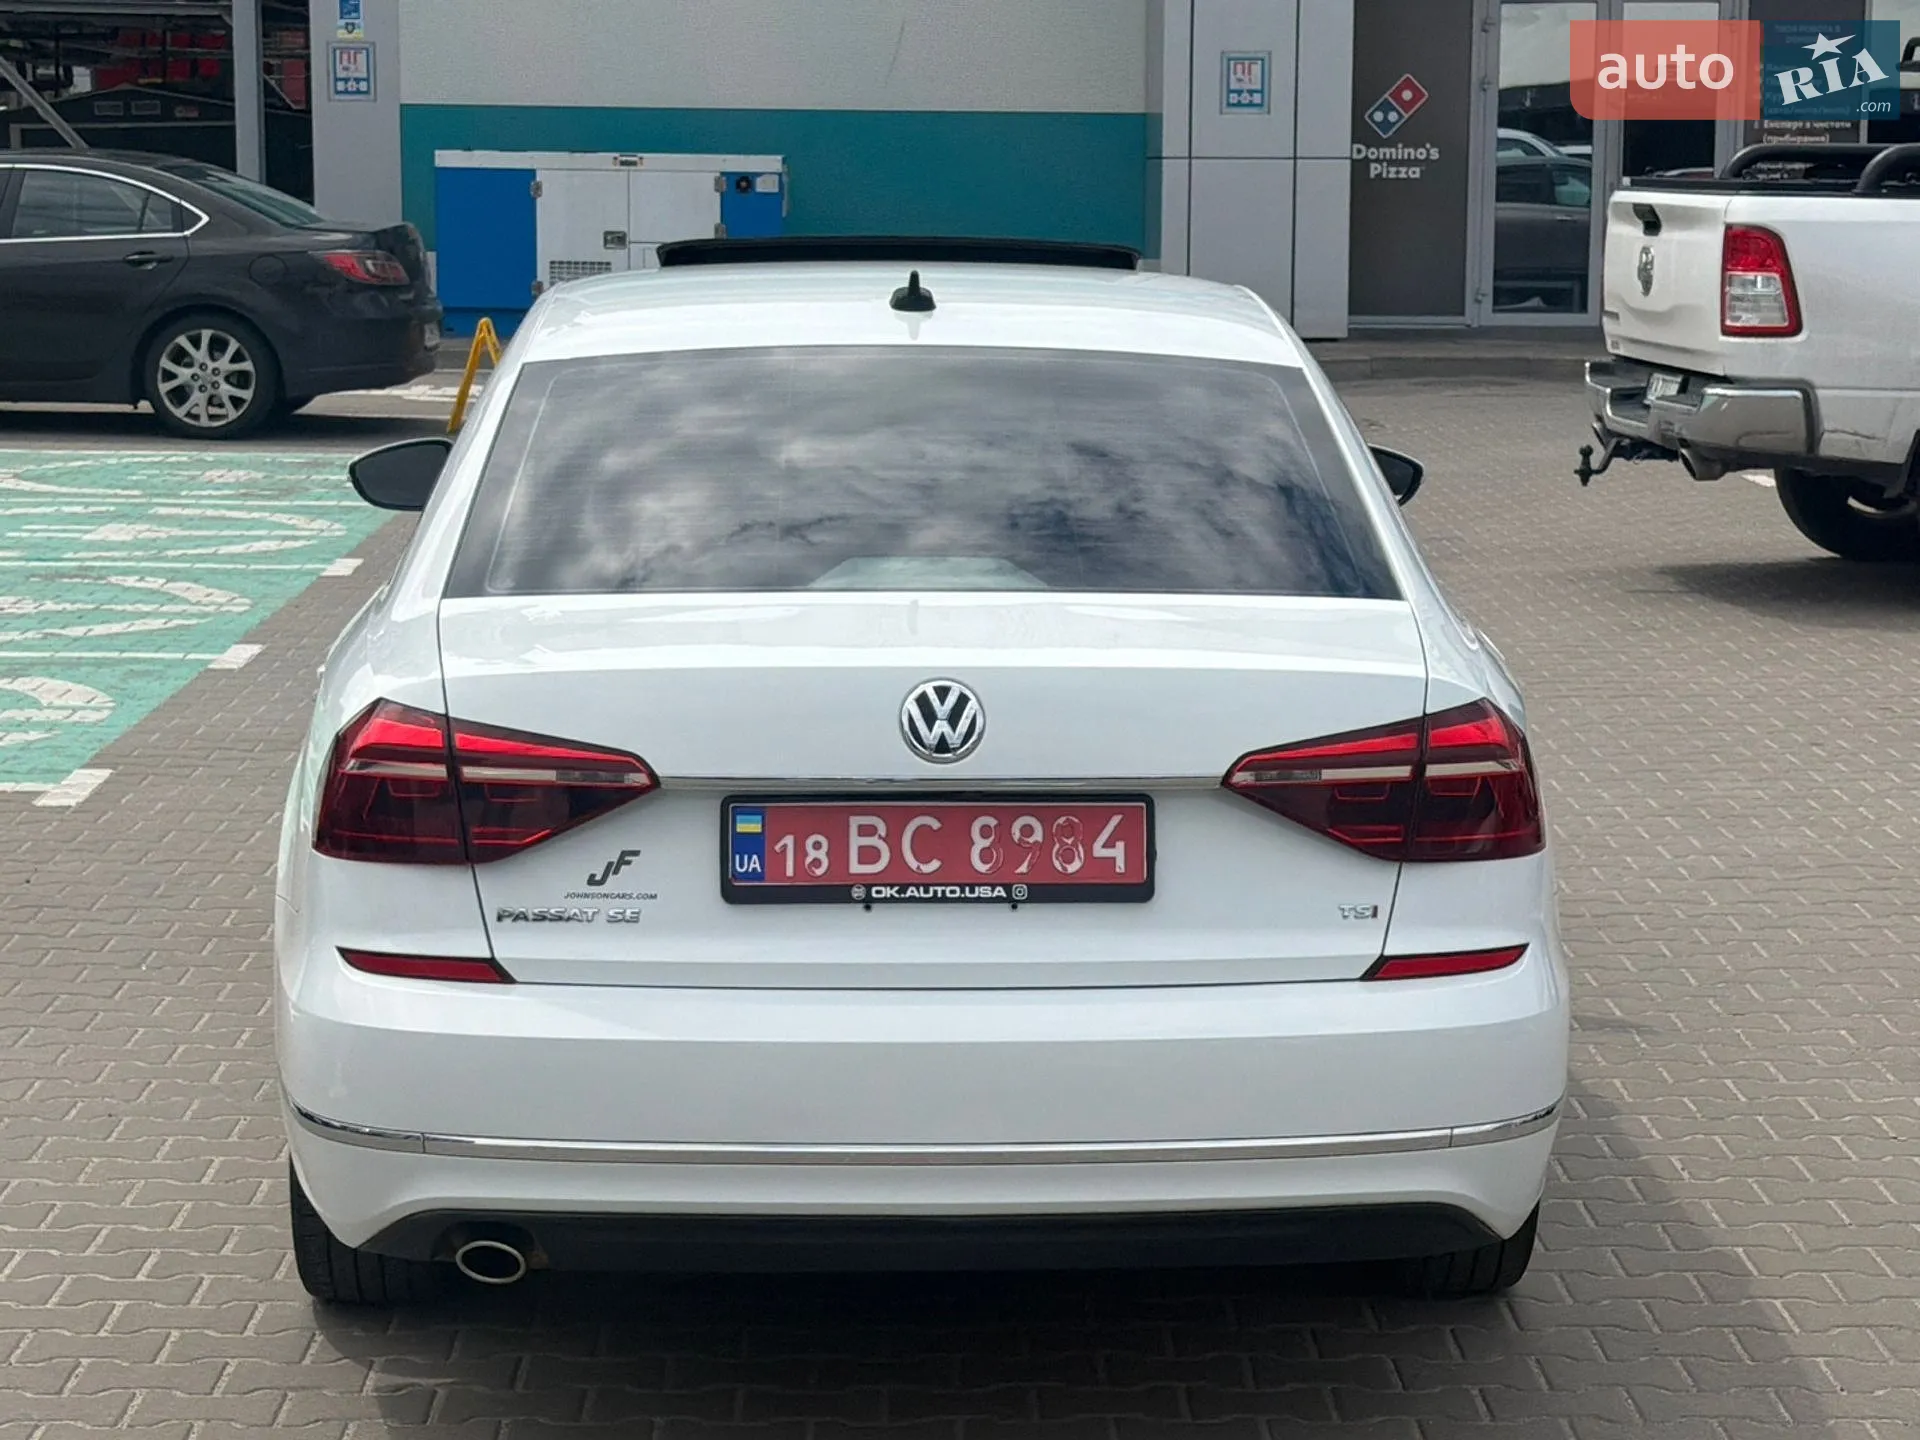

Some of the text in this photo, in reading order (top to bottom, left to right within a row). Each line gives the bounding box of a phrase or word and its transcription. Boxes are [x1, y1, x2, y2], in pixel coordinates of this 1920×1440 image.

[1352, 143, 1440, 160] Domino's
[1369, 162, 1421, 179] Pizza
[901, 679, 985, 763] VW
[773, 814, 1126, 877] 18 BC 8984
[587, 850, 641, 887] JF
[735, 853, 761, 873] UA
[563, 891, 658, 901] JOHNSONCARS.COM
[871, 885, 1007, 899] OK.AUTO.USA
[496, 906, 642, 924] PASSAT SE
[1338, 903, 1378, 919] TSI
